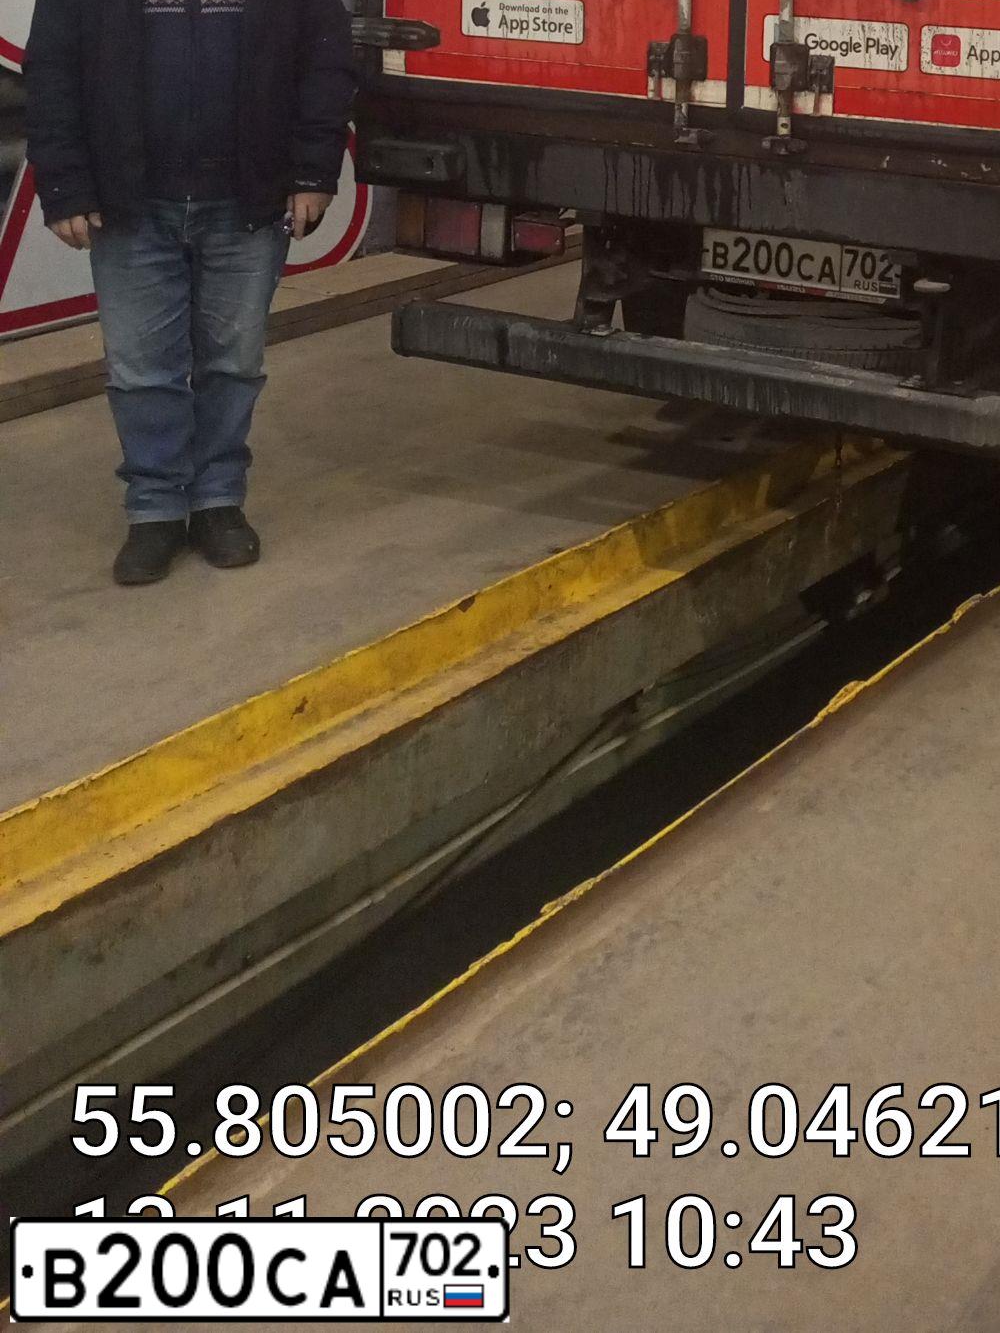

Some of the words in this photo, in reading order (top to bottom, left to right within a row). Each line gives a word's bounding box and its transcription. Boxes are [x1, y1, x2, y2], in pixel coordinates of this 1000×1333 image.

[499, 2, 540, 13] Download
[555, 6, 569, 15] the
[498, 14, 529, 34] App
[532, 17, 573, 34] Store
[804, 33, 862, 57] Google
[865, 37, 898, 60] Play
[844, 248, 893, 283] 702
[854, 279, 878, 293] RUS
